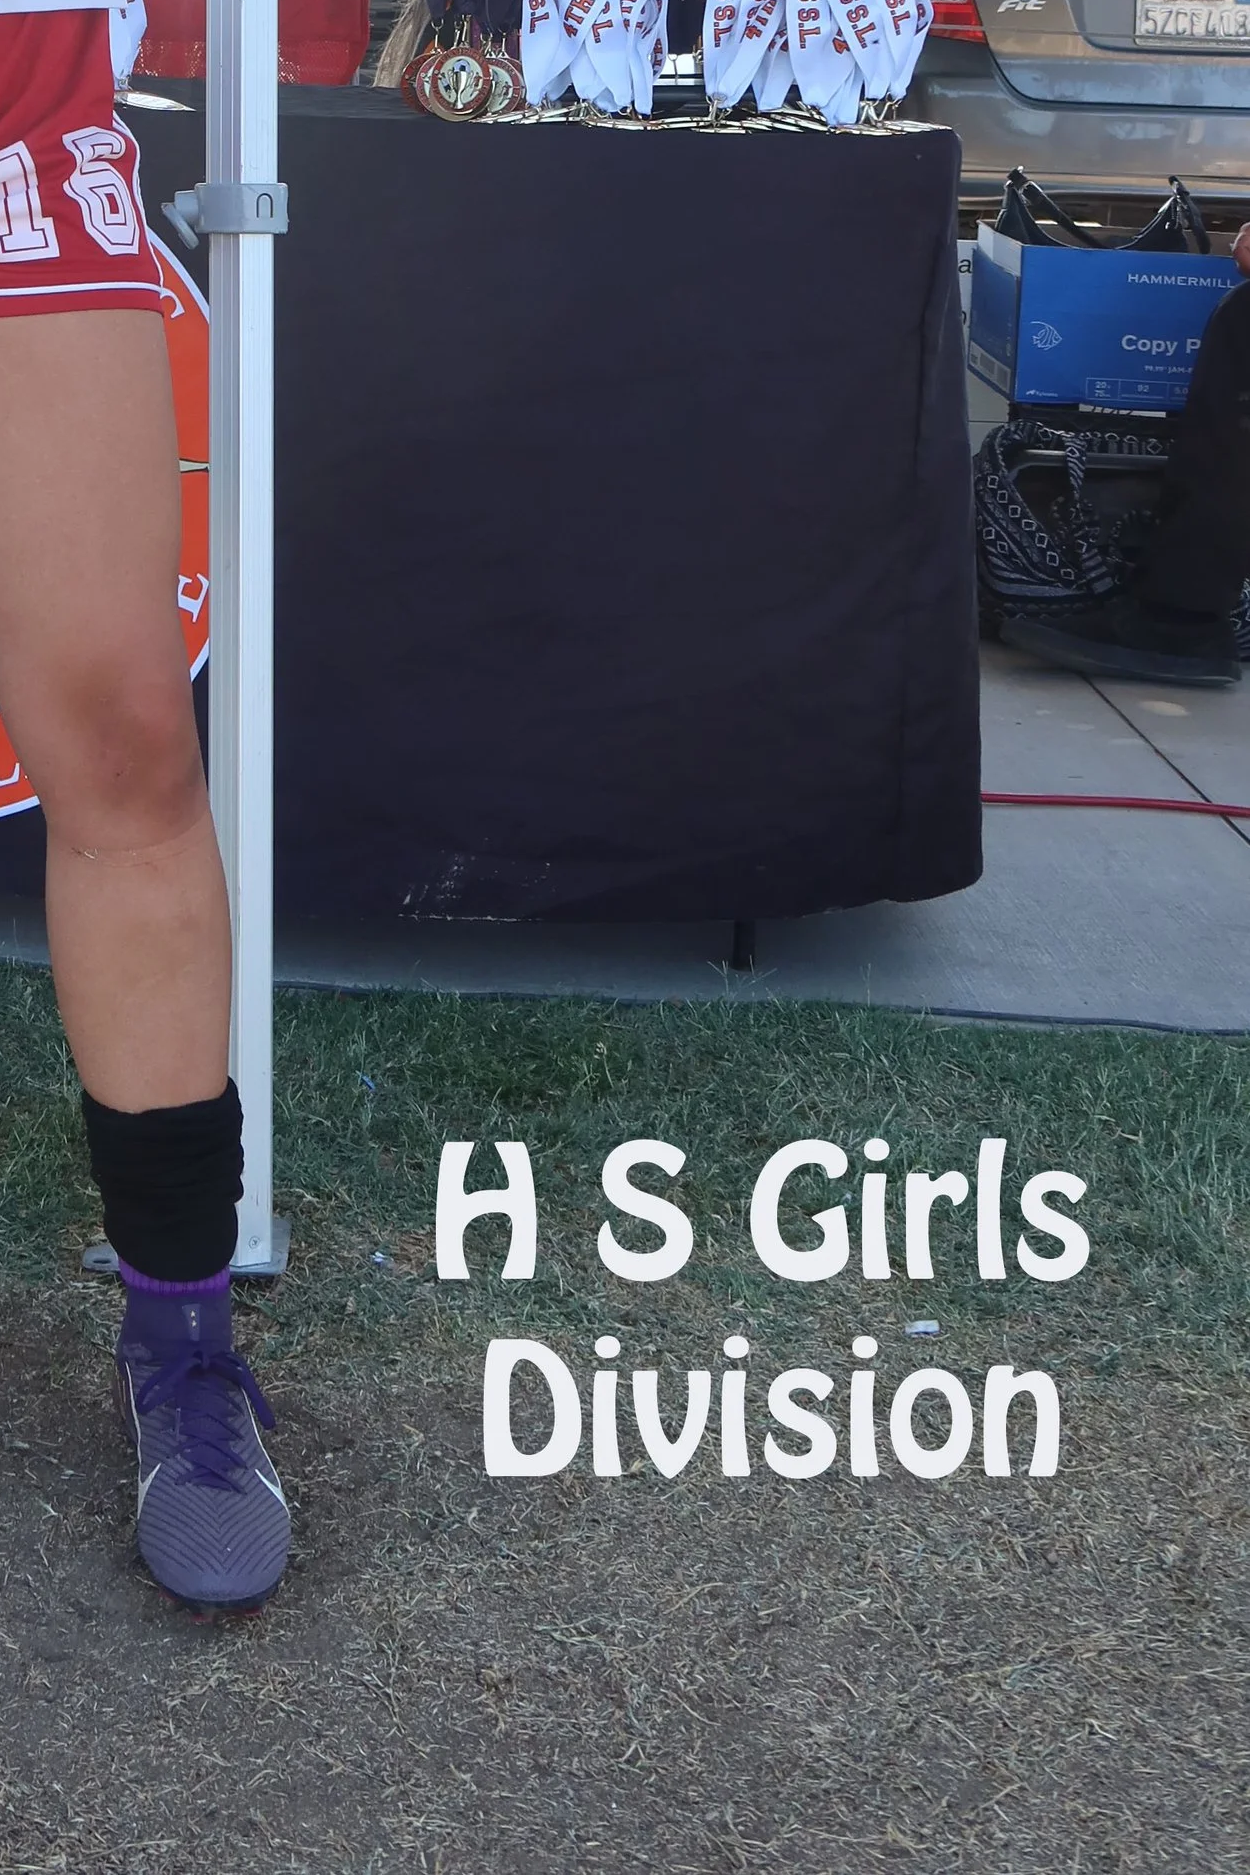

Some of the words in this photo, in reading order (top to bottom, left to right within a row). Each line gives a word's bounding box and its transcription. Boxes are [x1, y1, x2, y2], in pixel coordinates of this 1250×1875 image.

[713, 4, 736, 48] S.L.
[797, 7, 821, 49] S.L.
[846, 4, 877, 49] S.L.
[1127, 273, 1235, 289] HAMMERMILL
[1121, 334, 1178, 356] Copy
